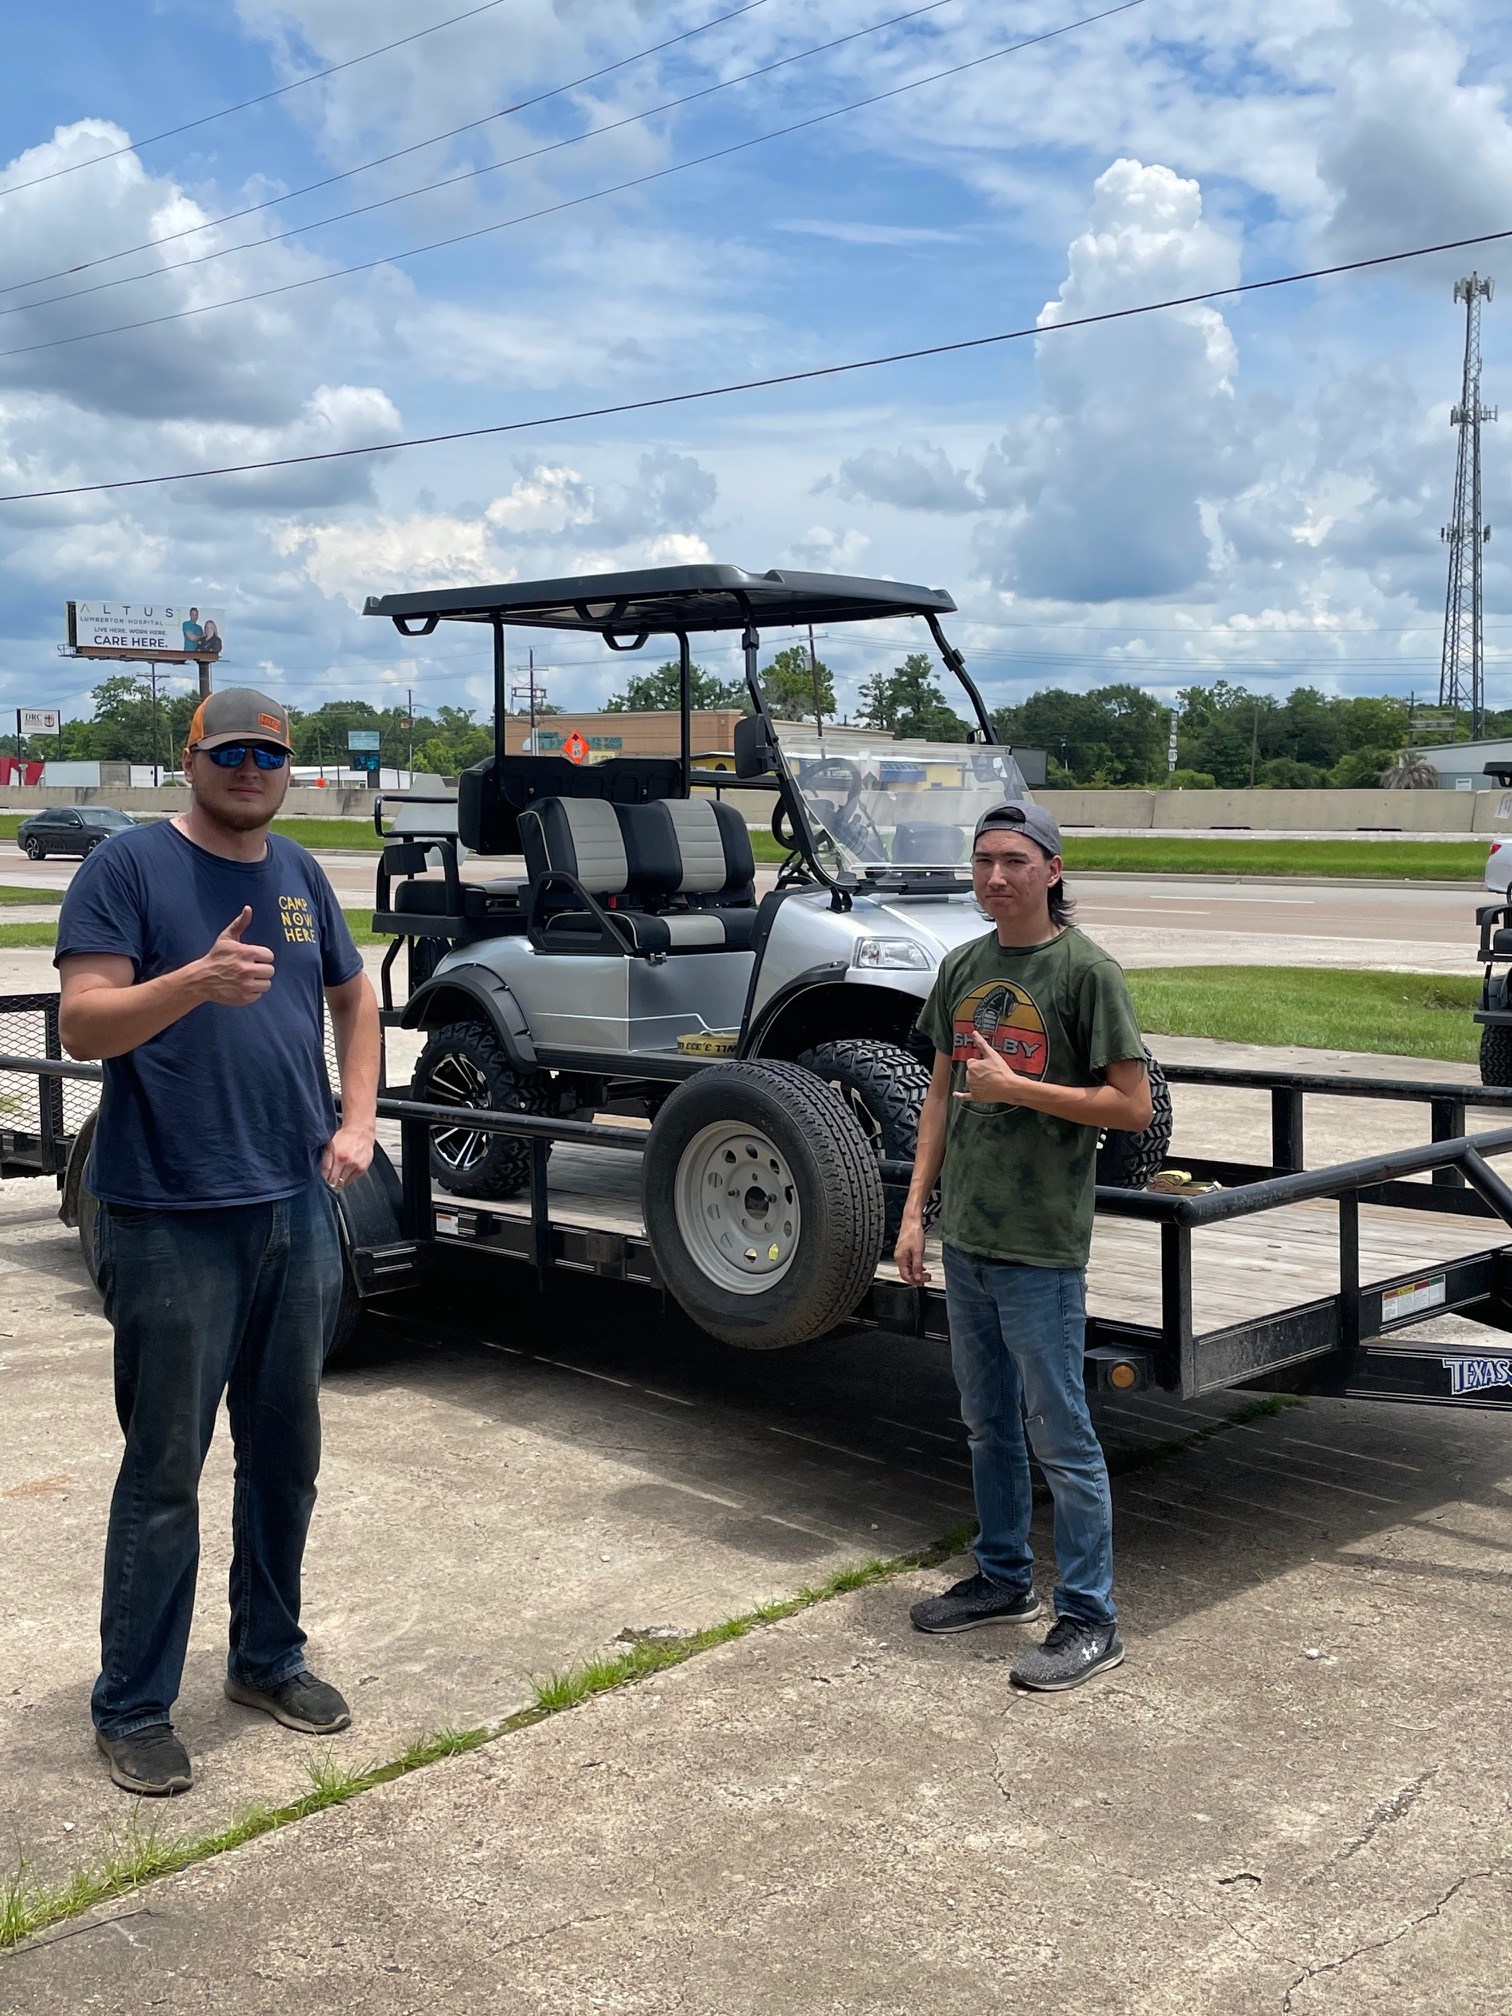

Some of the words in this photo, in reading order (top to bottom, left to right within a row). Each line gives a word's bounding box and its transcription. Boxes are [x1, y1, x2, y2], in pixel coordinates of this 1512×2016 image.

[80, 603, 174, 618] ALTUS
[128, 619, 164, 627] HOSPITAL
[94, 635, 128, 646] CARE
[132, 637, 168, 648] HERE.
[25, 713, 43, 721] DRC
[278, 895, 308, 912] CAMP
[281, 911, 313, 927] NOW
[284, 928, 317, 943] HERE
[1445, 1360, 1509, 1393] TEXAS
